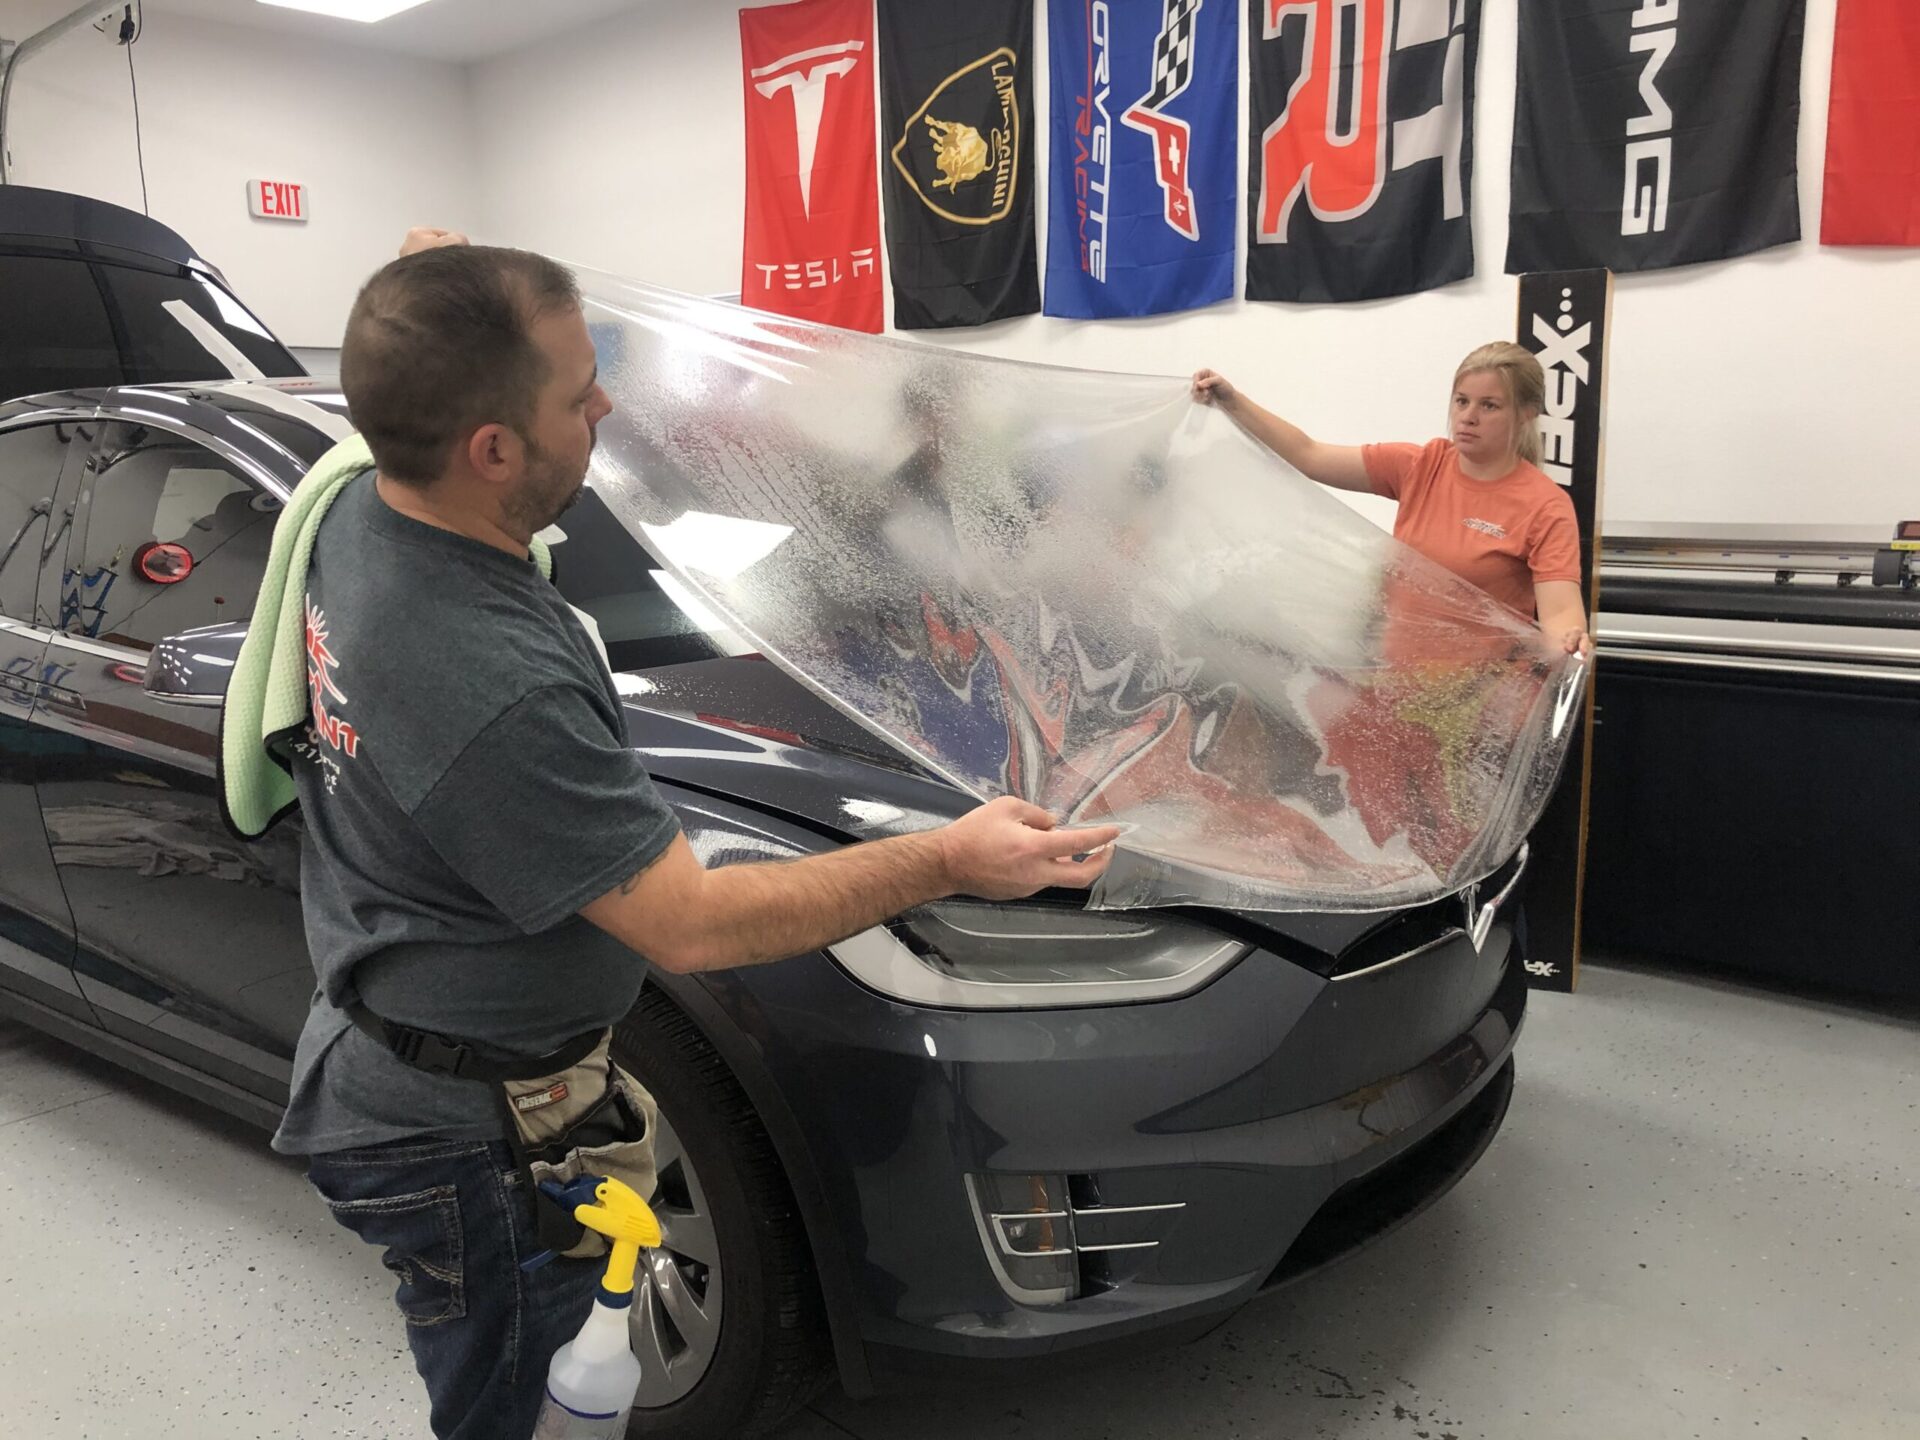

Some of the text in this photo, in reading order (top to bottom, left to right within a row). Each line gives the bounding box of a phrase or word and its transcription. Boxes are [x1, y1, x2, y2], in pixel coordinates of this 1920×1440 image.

[260, 181, 301, 217] EXIT
[991, 60, 1014, 208] LAMGHINI
[1074, 95, 1093, 273] RACING
[1090, 0, 1112, 284] ORVETTE
[755, 247, 874, 290] TESLA
